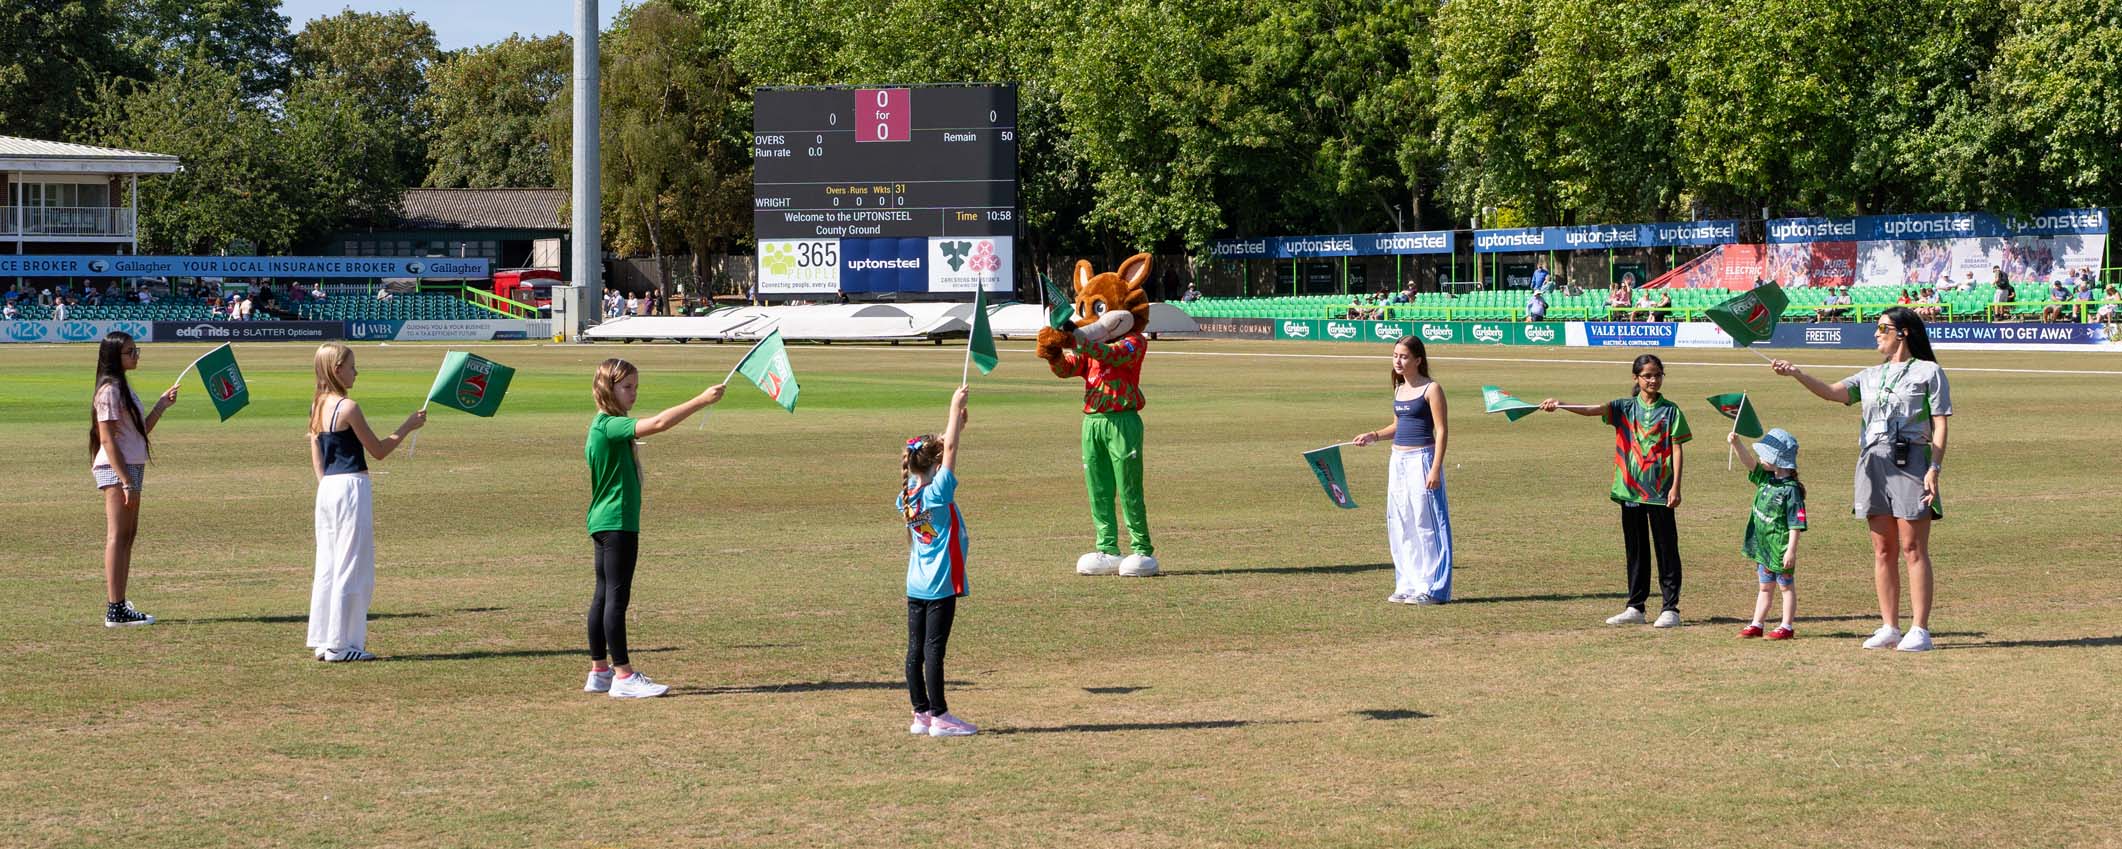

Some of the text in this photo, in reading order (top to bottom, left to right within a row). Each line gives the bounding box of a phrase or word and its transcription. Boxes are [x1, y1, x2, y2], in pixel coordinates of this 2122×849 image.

[877, 90, 888, 108] 0
[829, 113, 837, 126] 0
[876, 110, 890, 120] for
[990, 111, 997, 122] 0
[877, 123, 889, 140] 0
[944, 131, 1013, 142] Remain 50
[755, 135, 822, 145] OVERS 0
[755, 147, 823, 157] Run rate 0.0
[826, 184, 905, 194] Overs Runs Wkts 31
[755, 197, 904, 207] WRIGHT 0 0 0 0
[785, 211, 912, 222] Welcome to the UPTONSTEEL
[956, 211, 1012, 221] Time 10:58
[816, 225, 881, 236] County Ground
[1659, 223, 1734, 242] uptonsteel
[1771, 219, 1856, 240] uptonsteel
[1884, 215, 1975, 237] uptonsteel
[1375, 233, 1447, 253] uptonsteel
[1477, 231, 1545, 250] uptonsteel
[1566, 227, 1637, 247] uptonsteel
[1286, 236, 1353, 255] uptonsteel
[797, 242, 837, 267] 365
[1, 261, 17, 271] CE
[23, 261, 78, 271] BROKER
[115, 261, 172, 273] Gallagher
[183, 262, 217, 272] YOUR
[222, 262, 264, 272] LOCAL
[269, 262, 341, 272] INSURANCE
[346, 263, 396, 273] BROKER
[430, 263, 482, 274] Gallagher
[848, 258, 920, 270] uptonsteel
[1725, 266, 1763, 275] ELECTRIC
[8, 321, 43, 337] M2K
[59, 321, 94, 337] M2K
[243, 328, 286, 337] SLATTER
[287, 328, 323, 338] Opticians
[368, 324, 392, 334] WBR
[1239, 324, 1272, 334] COMPANY
[1283, 321, 1310, 337] Carlsberg
[1327, 321, 1357, 339] Carlsberg
[1375, 322, 1403, 339] Carlsberg
[1422, 323, 1453, 341] Carlsberg
[1472, 324, 1503, 342] Carlsberg
[1524, 325, 1555, 342] Carlsberg
[1590, 325, 1672, 336] VALE ELECTRICS
[1944, 327, 1969, 339] EASY
[1972, 327, 1997, 339] WAY
[2000, 327, 2014, 339] TO
[2016, 327, 2038, 339] GET
[2040, 327, 2073, 339] AWAY
[1805, 330, 1842, 342] FREETHS
